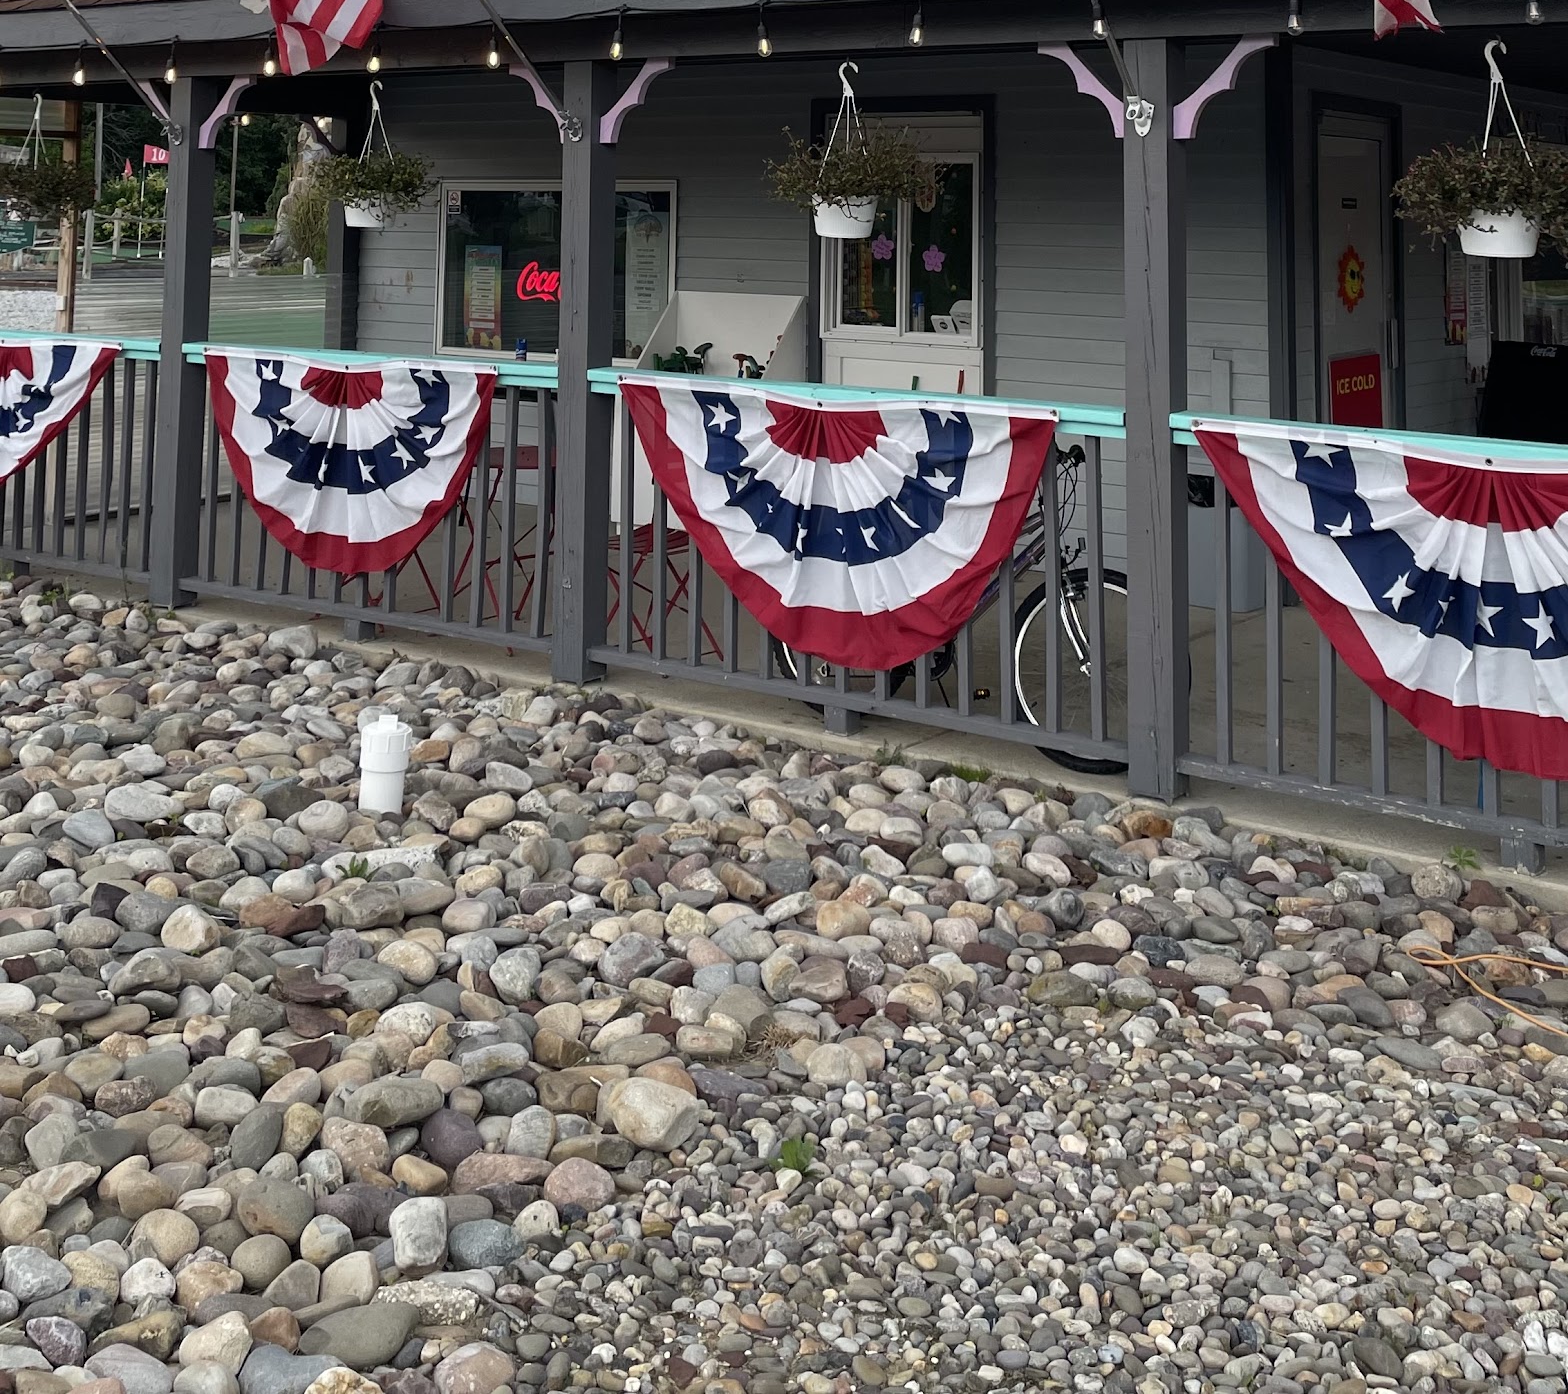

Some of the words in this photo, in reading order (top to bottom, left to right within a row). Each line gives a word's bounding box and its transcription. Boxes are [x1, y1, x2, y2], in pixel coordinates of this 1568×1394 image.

[151, 147, 166, 161] 10
[517, 261, 562, 301] Coca
[1336, 378, 1350, 395] ICE
[1352, 374, 1375, 391] COLD
